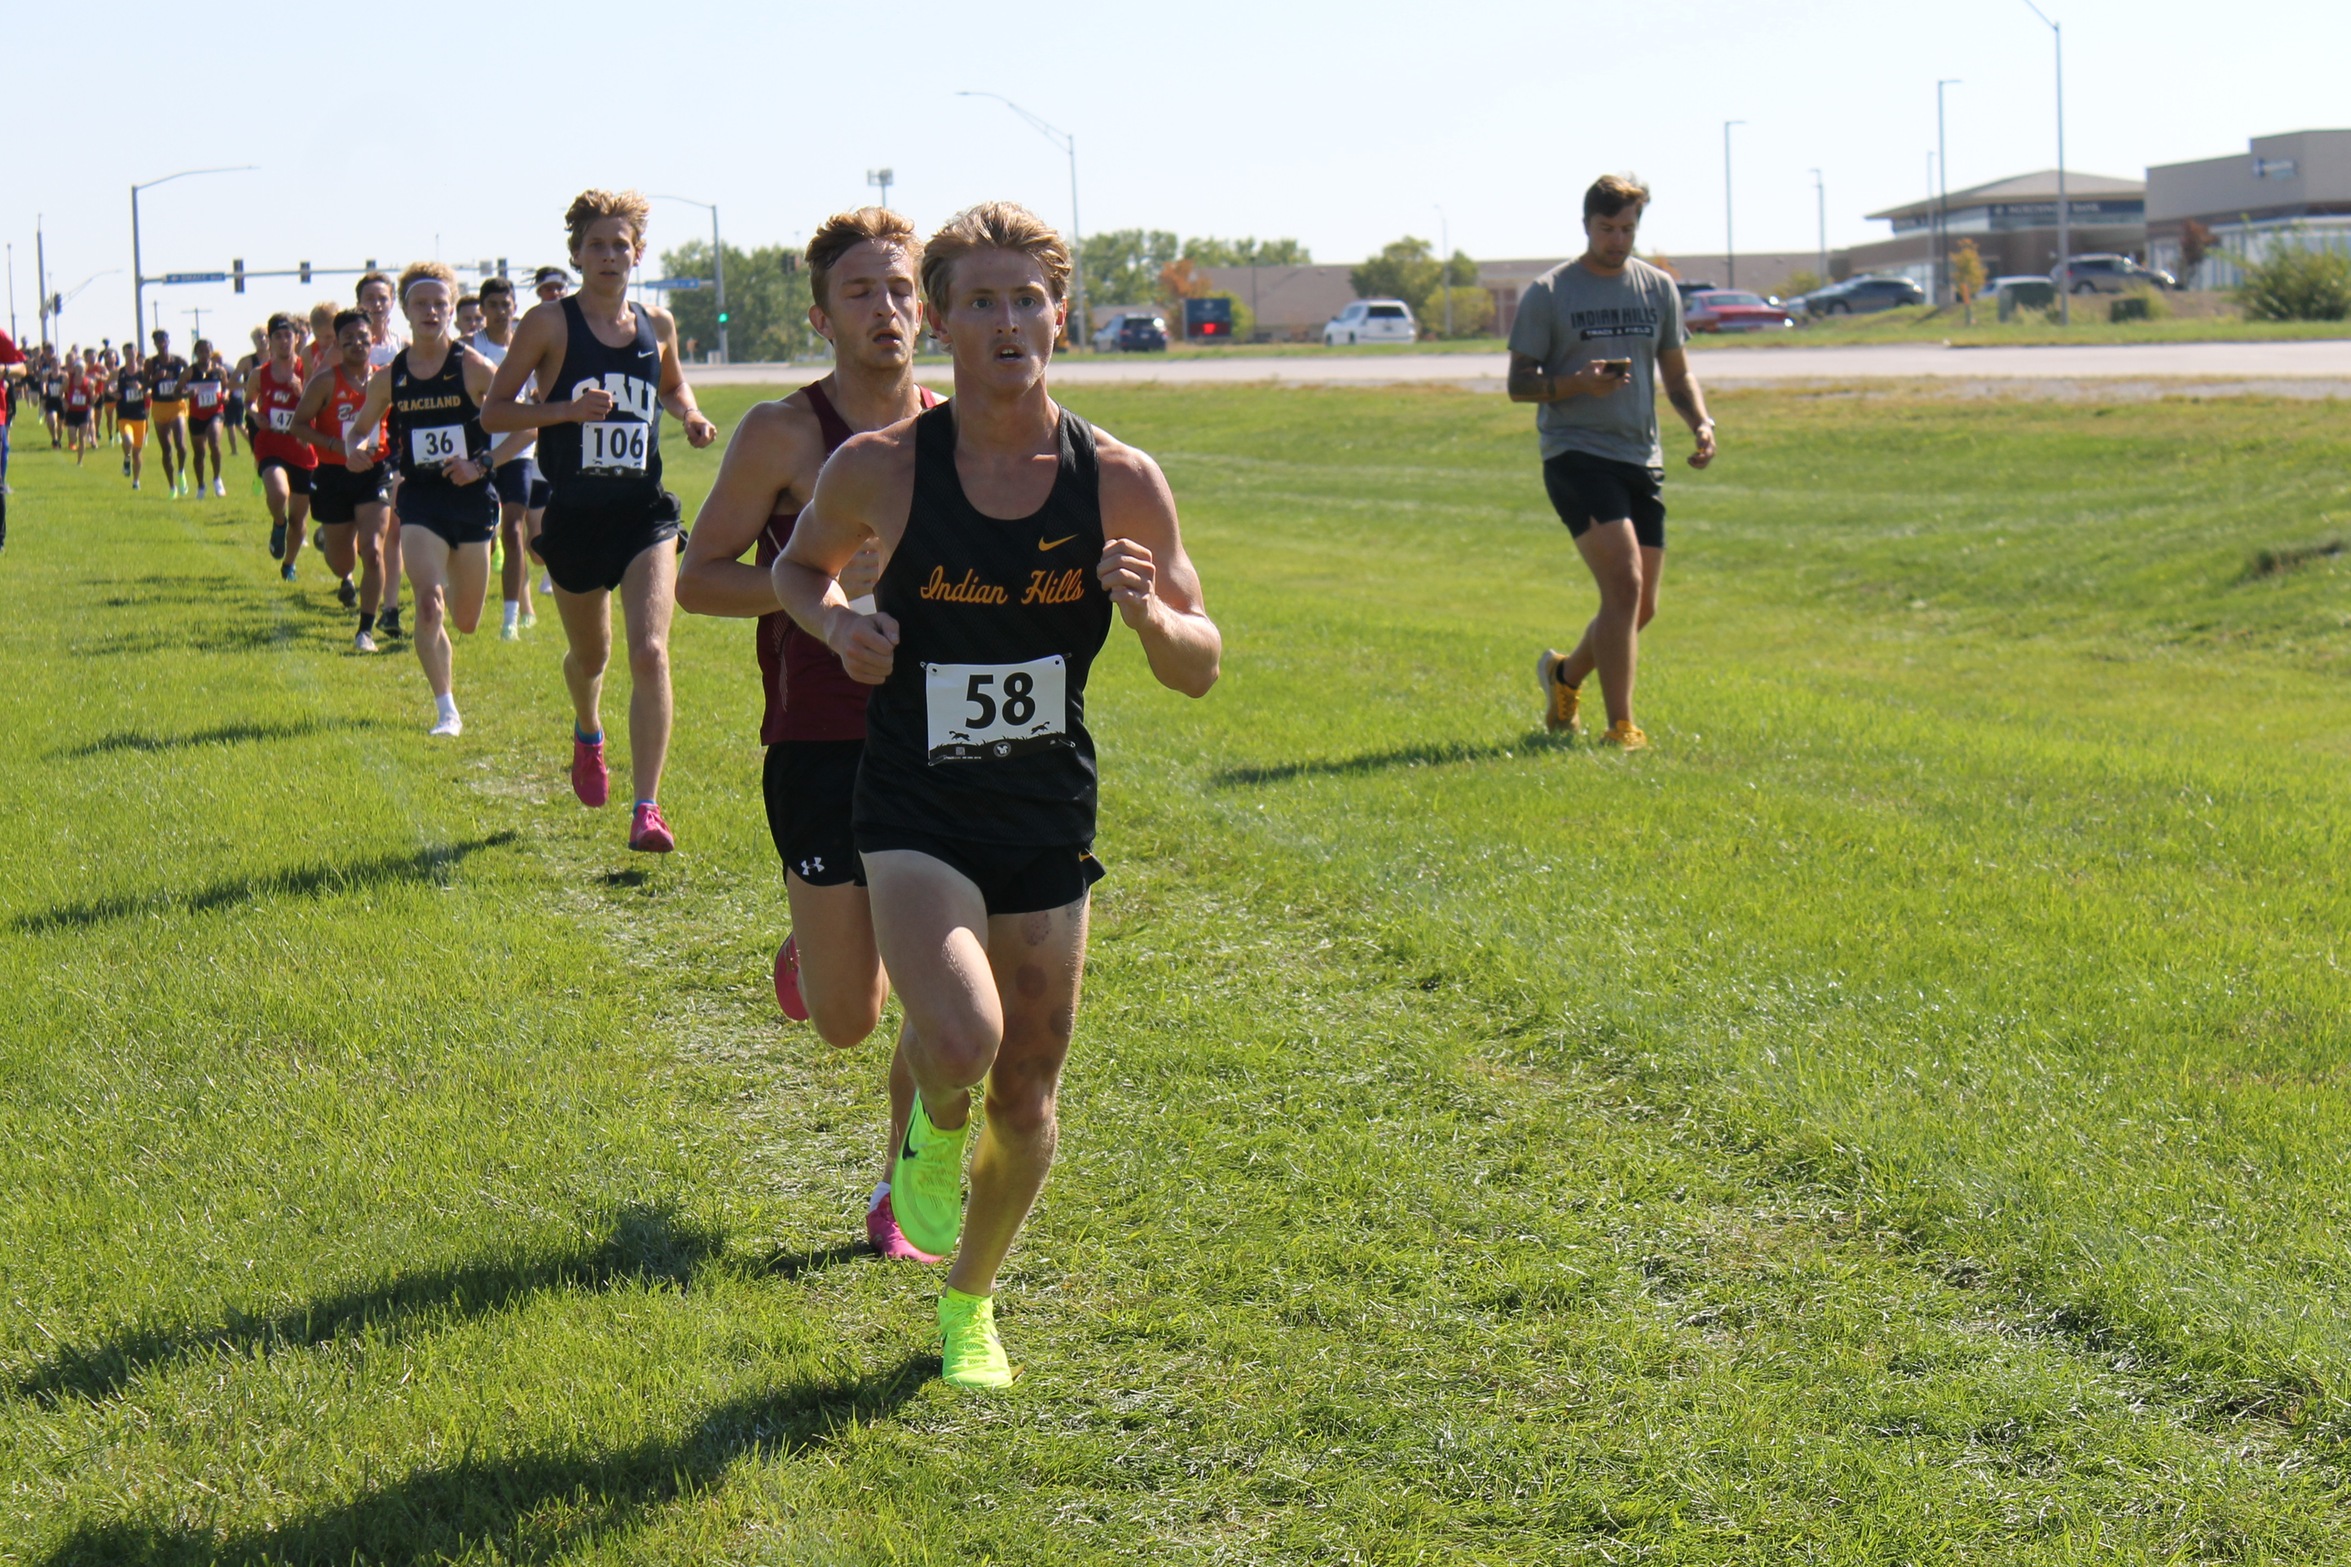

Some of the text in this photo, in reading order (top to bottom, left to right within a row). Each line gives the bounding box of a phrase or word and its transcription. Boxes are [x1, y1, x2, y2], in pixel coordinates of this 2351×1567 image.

[1571, 307, 1657, 328] INDIAN HILLS
[397, 395, 462, 412] GRACELAND
[276, 411, 293, 427] 47
[425, 431, 454, 456] 36
[594, 427, 644, 460] 106
[920, 565, 1085, 604] Indian Hills
[965, 672, 1036, 730] 58
